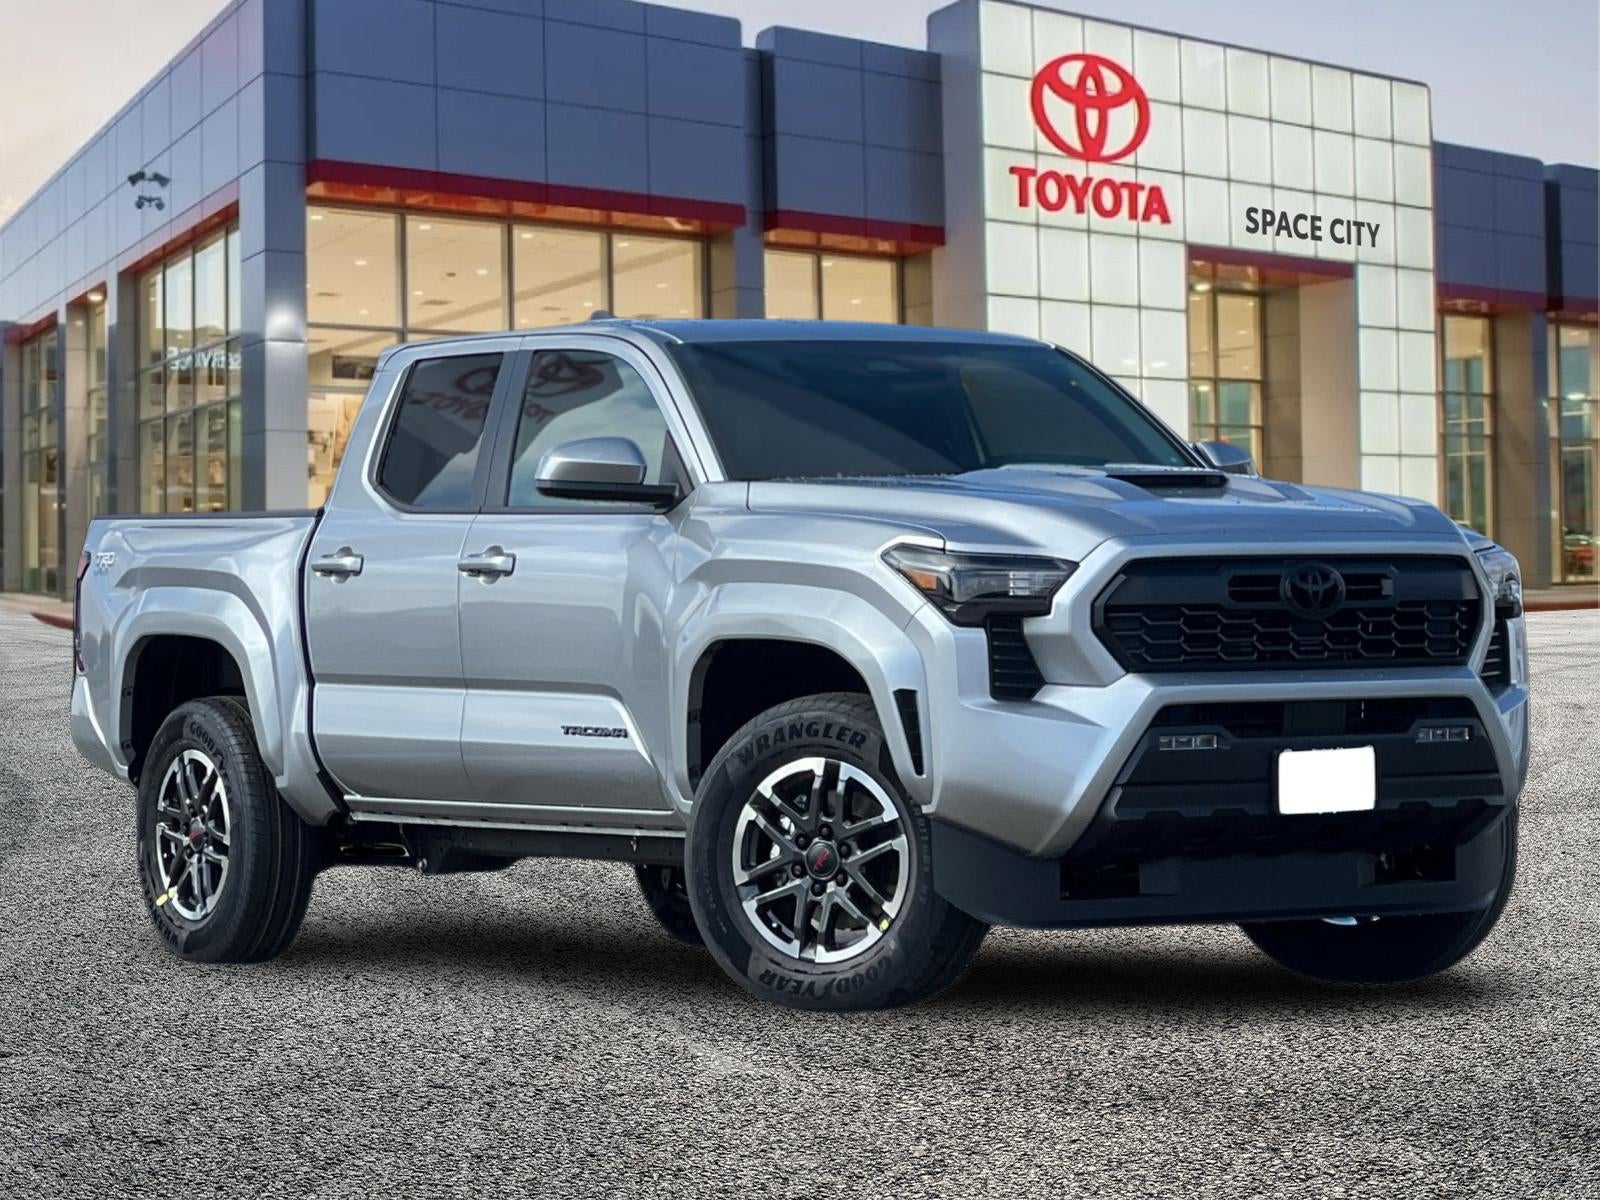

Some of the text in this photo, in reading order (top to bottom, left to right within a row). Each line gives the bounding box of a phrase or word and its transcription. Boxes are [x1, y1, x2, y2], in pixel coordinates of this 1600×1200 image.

[1009, 166, 1171, 224] TOYOTA
[1245, 206, 1380, 248] SPACE CITY
[96, 551, 116, 569] TRD
[560, 725, 628, 739] TACOMA
[737, 720, 867, 764] WRANGLER
